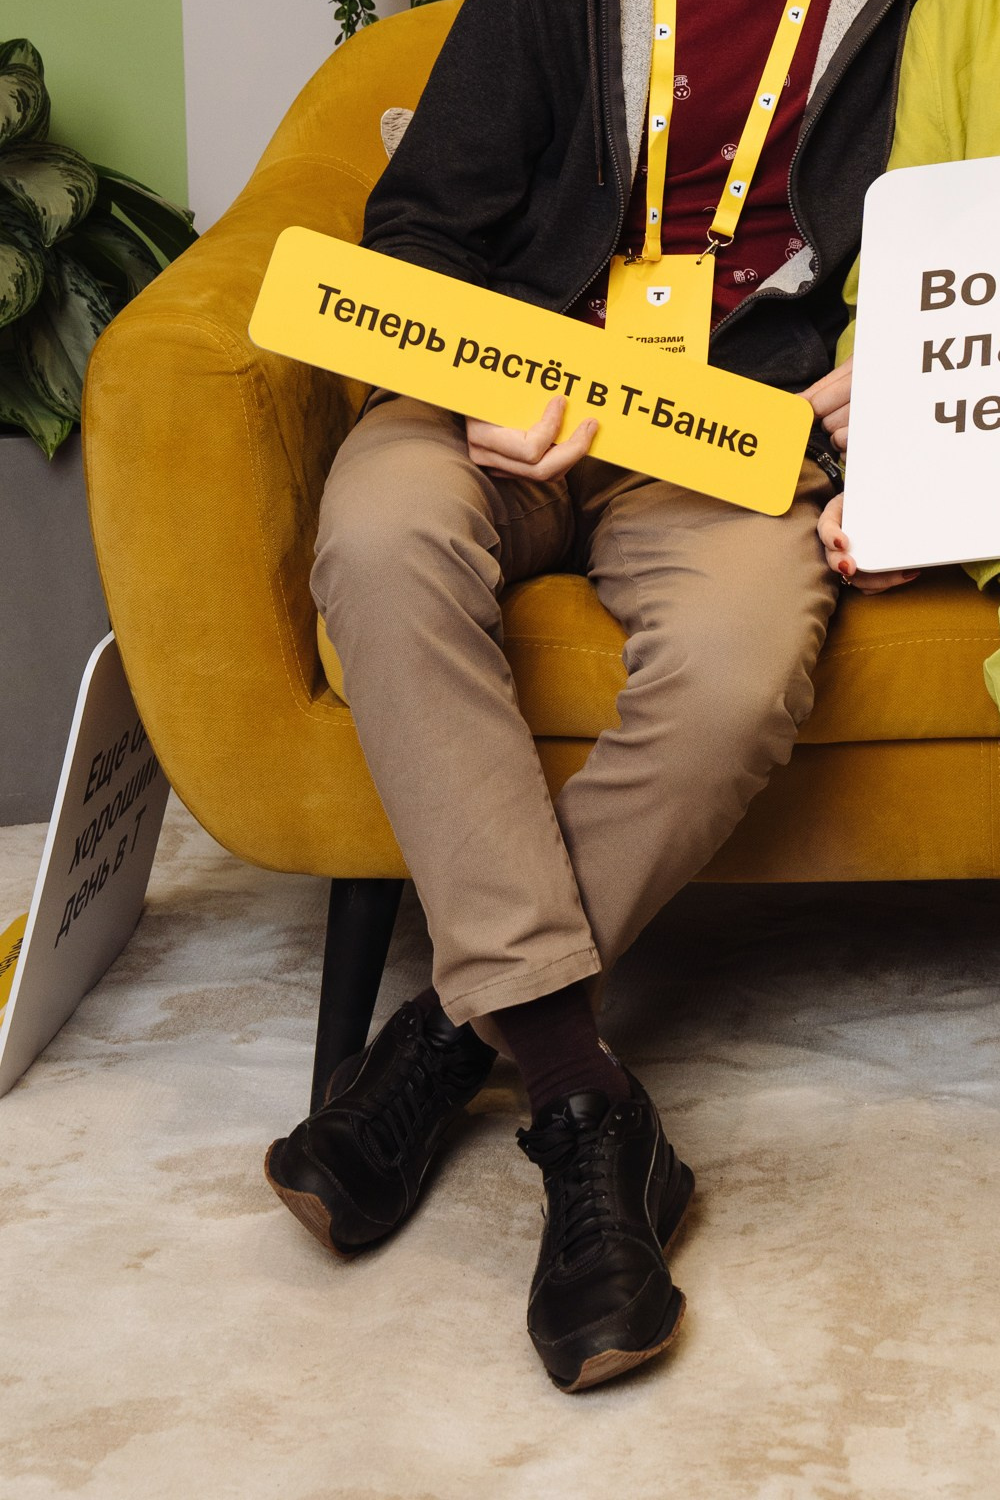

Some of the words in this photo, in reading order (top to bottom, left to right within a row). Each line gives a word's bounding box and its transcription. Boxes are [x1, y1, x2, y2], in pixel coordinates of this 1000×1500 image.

[318, 283, 446, 353] Теперь
[452, 338, 581, 397] растёт
[586, 381, 609, 407] в
[620, 384, 758, 457] Т-Банке
[83, 731, 129, 805] Еще
[54, 857, 110, 950] день
[112, 834, 128, 875] в
[130, 804, 147, 854] Т
